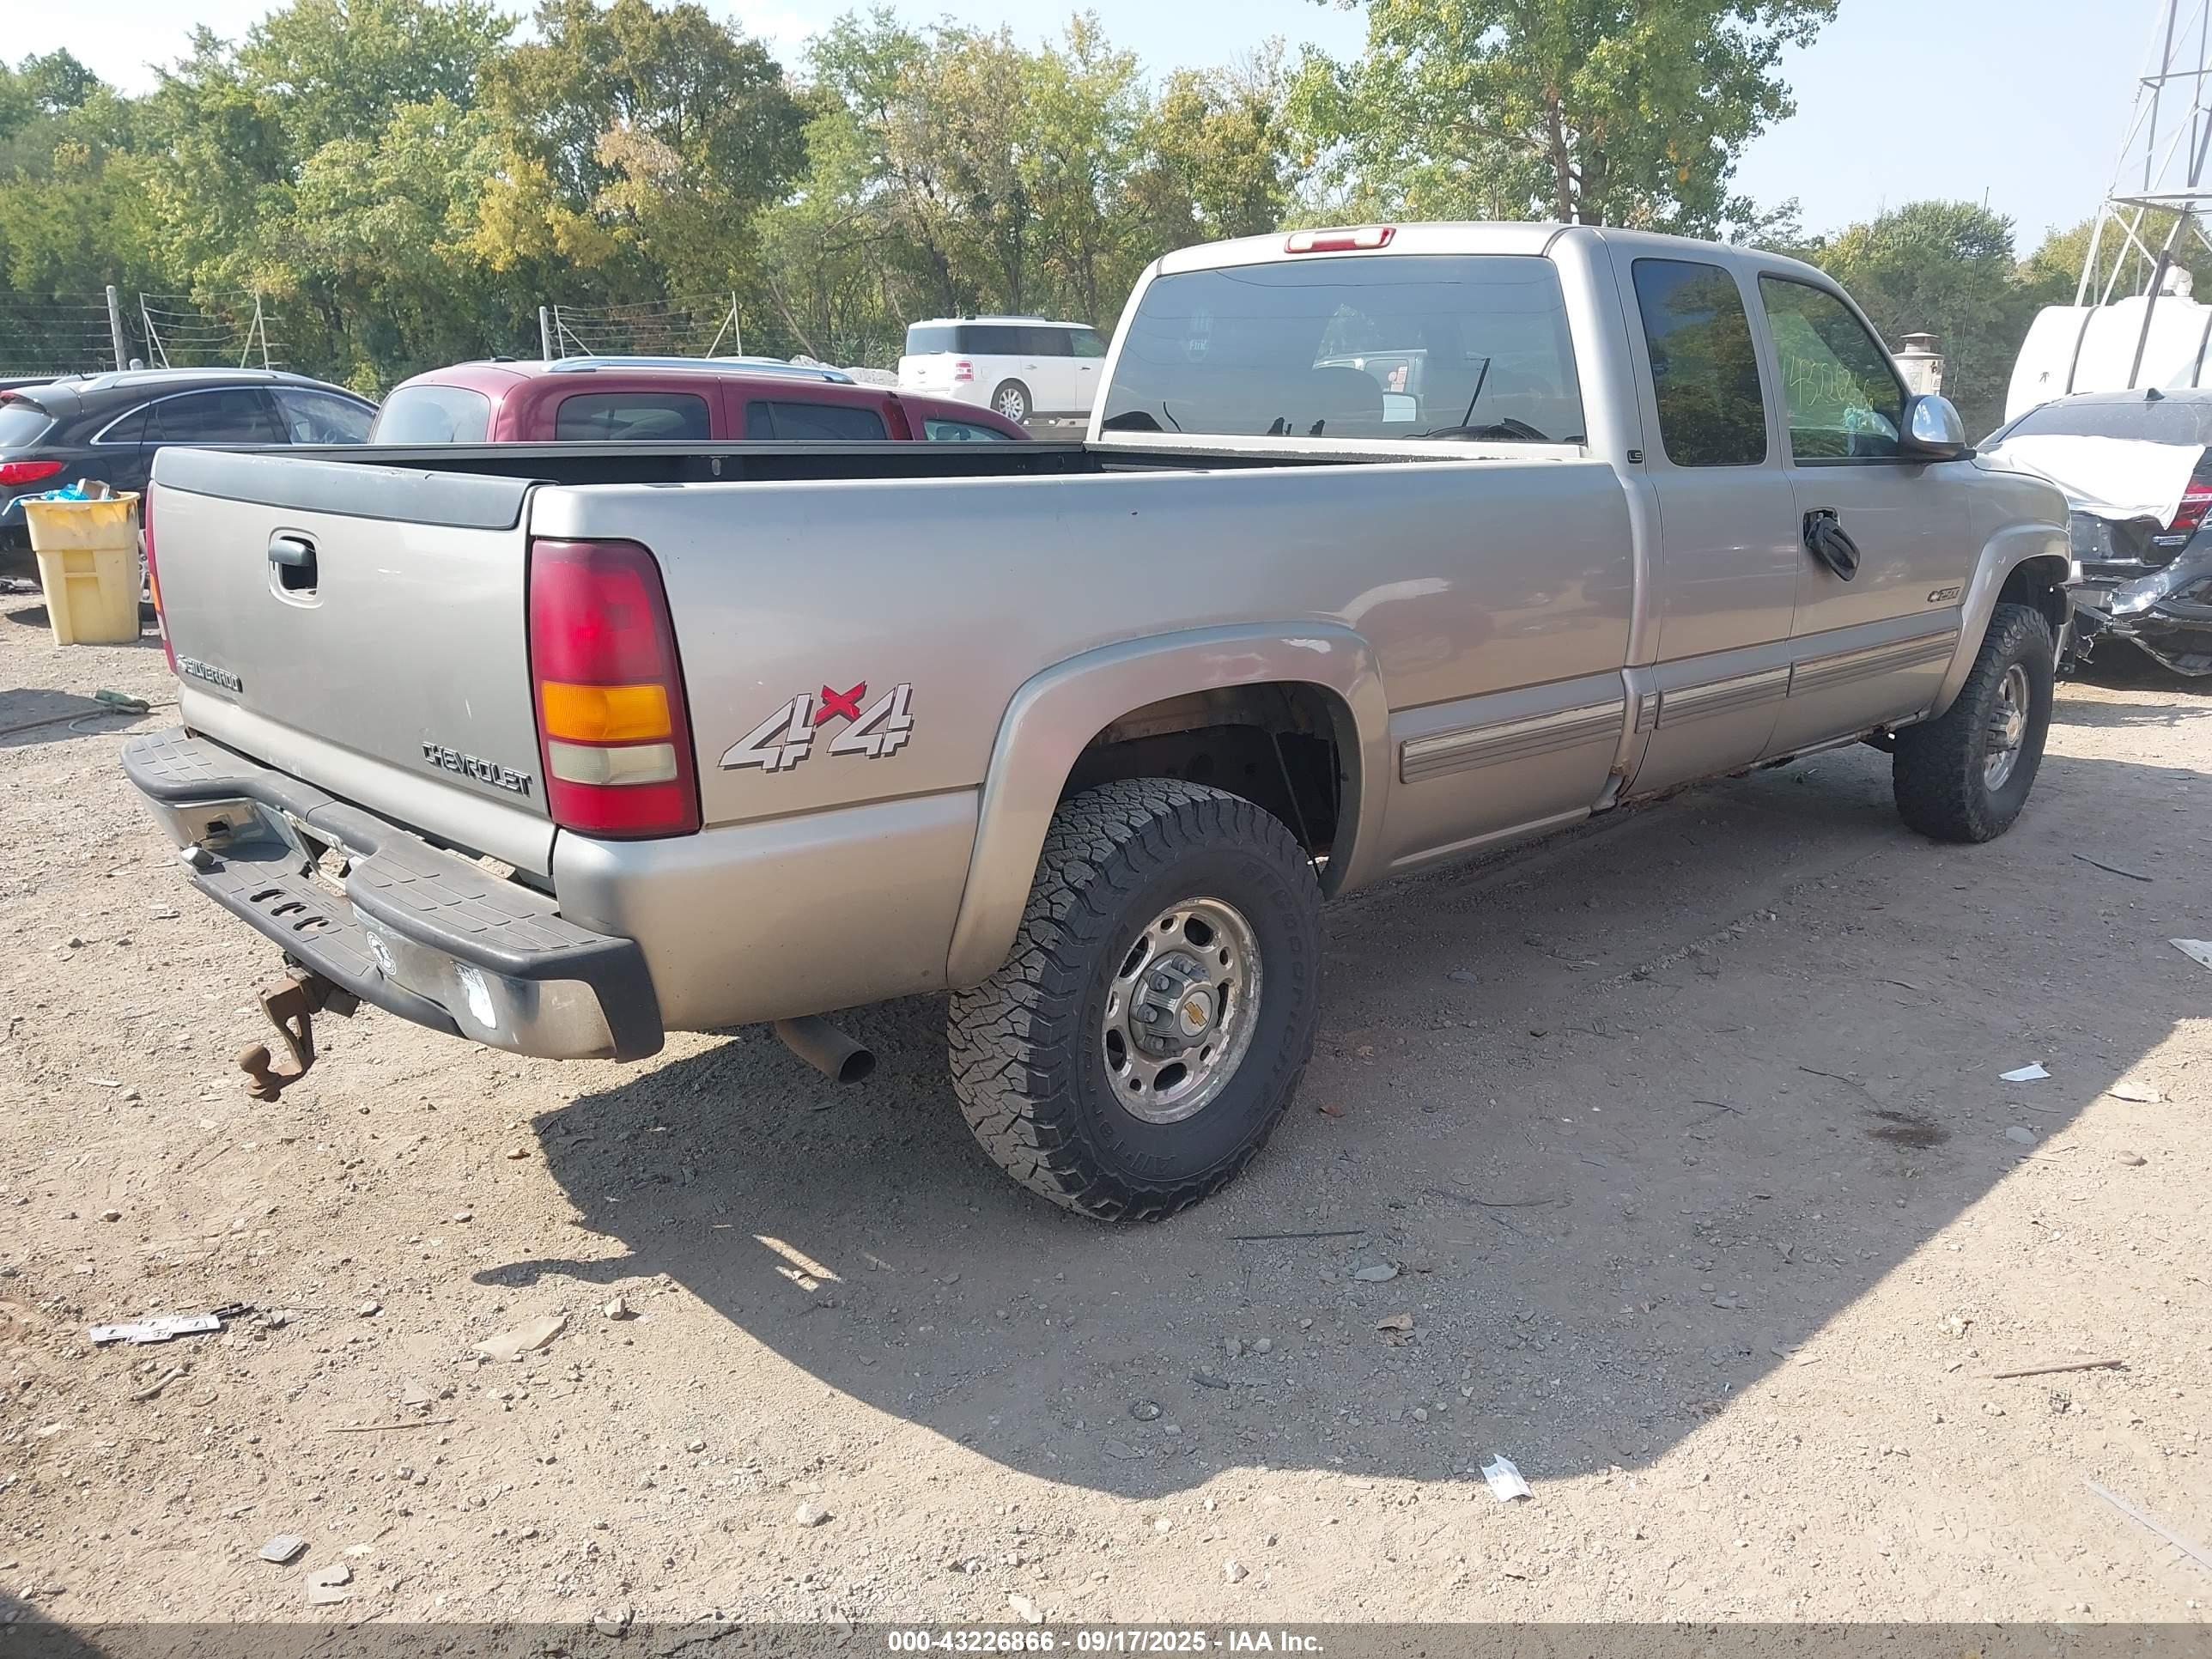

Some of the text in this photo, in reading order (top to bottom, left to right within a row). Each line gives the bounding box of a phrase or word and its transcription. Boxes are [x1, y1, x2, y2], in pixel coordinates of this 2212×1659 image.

[1628, 452, 1643, 461] LS
[185, 657, 243, 694] SILVERADO
[422, 741, 533, 798] CHEVROLET
